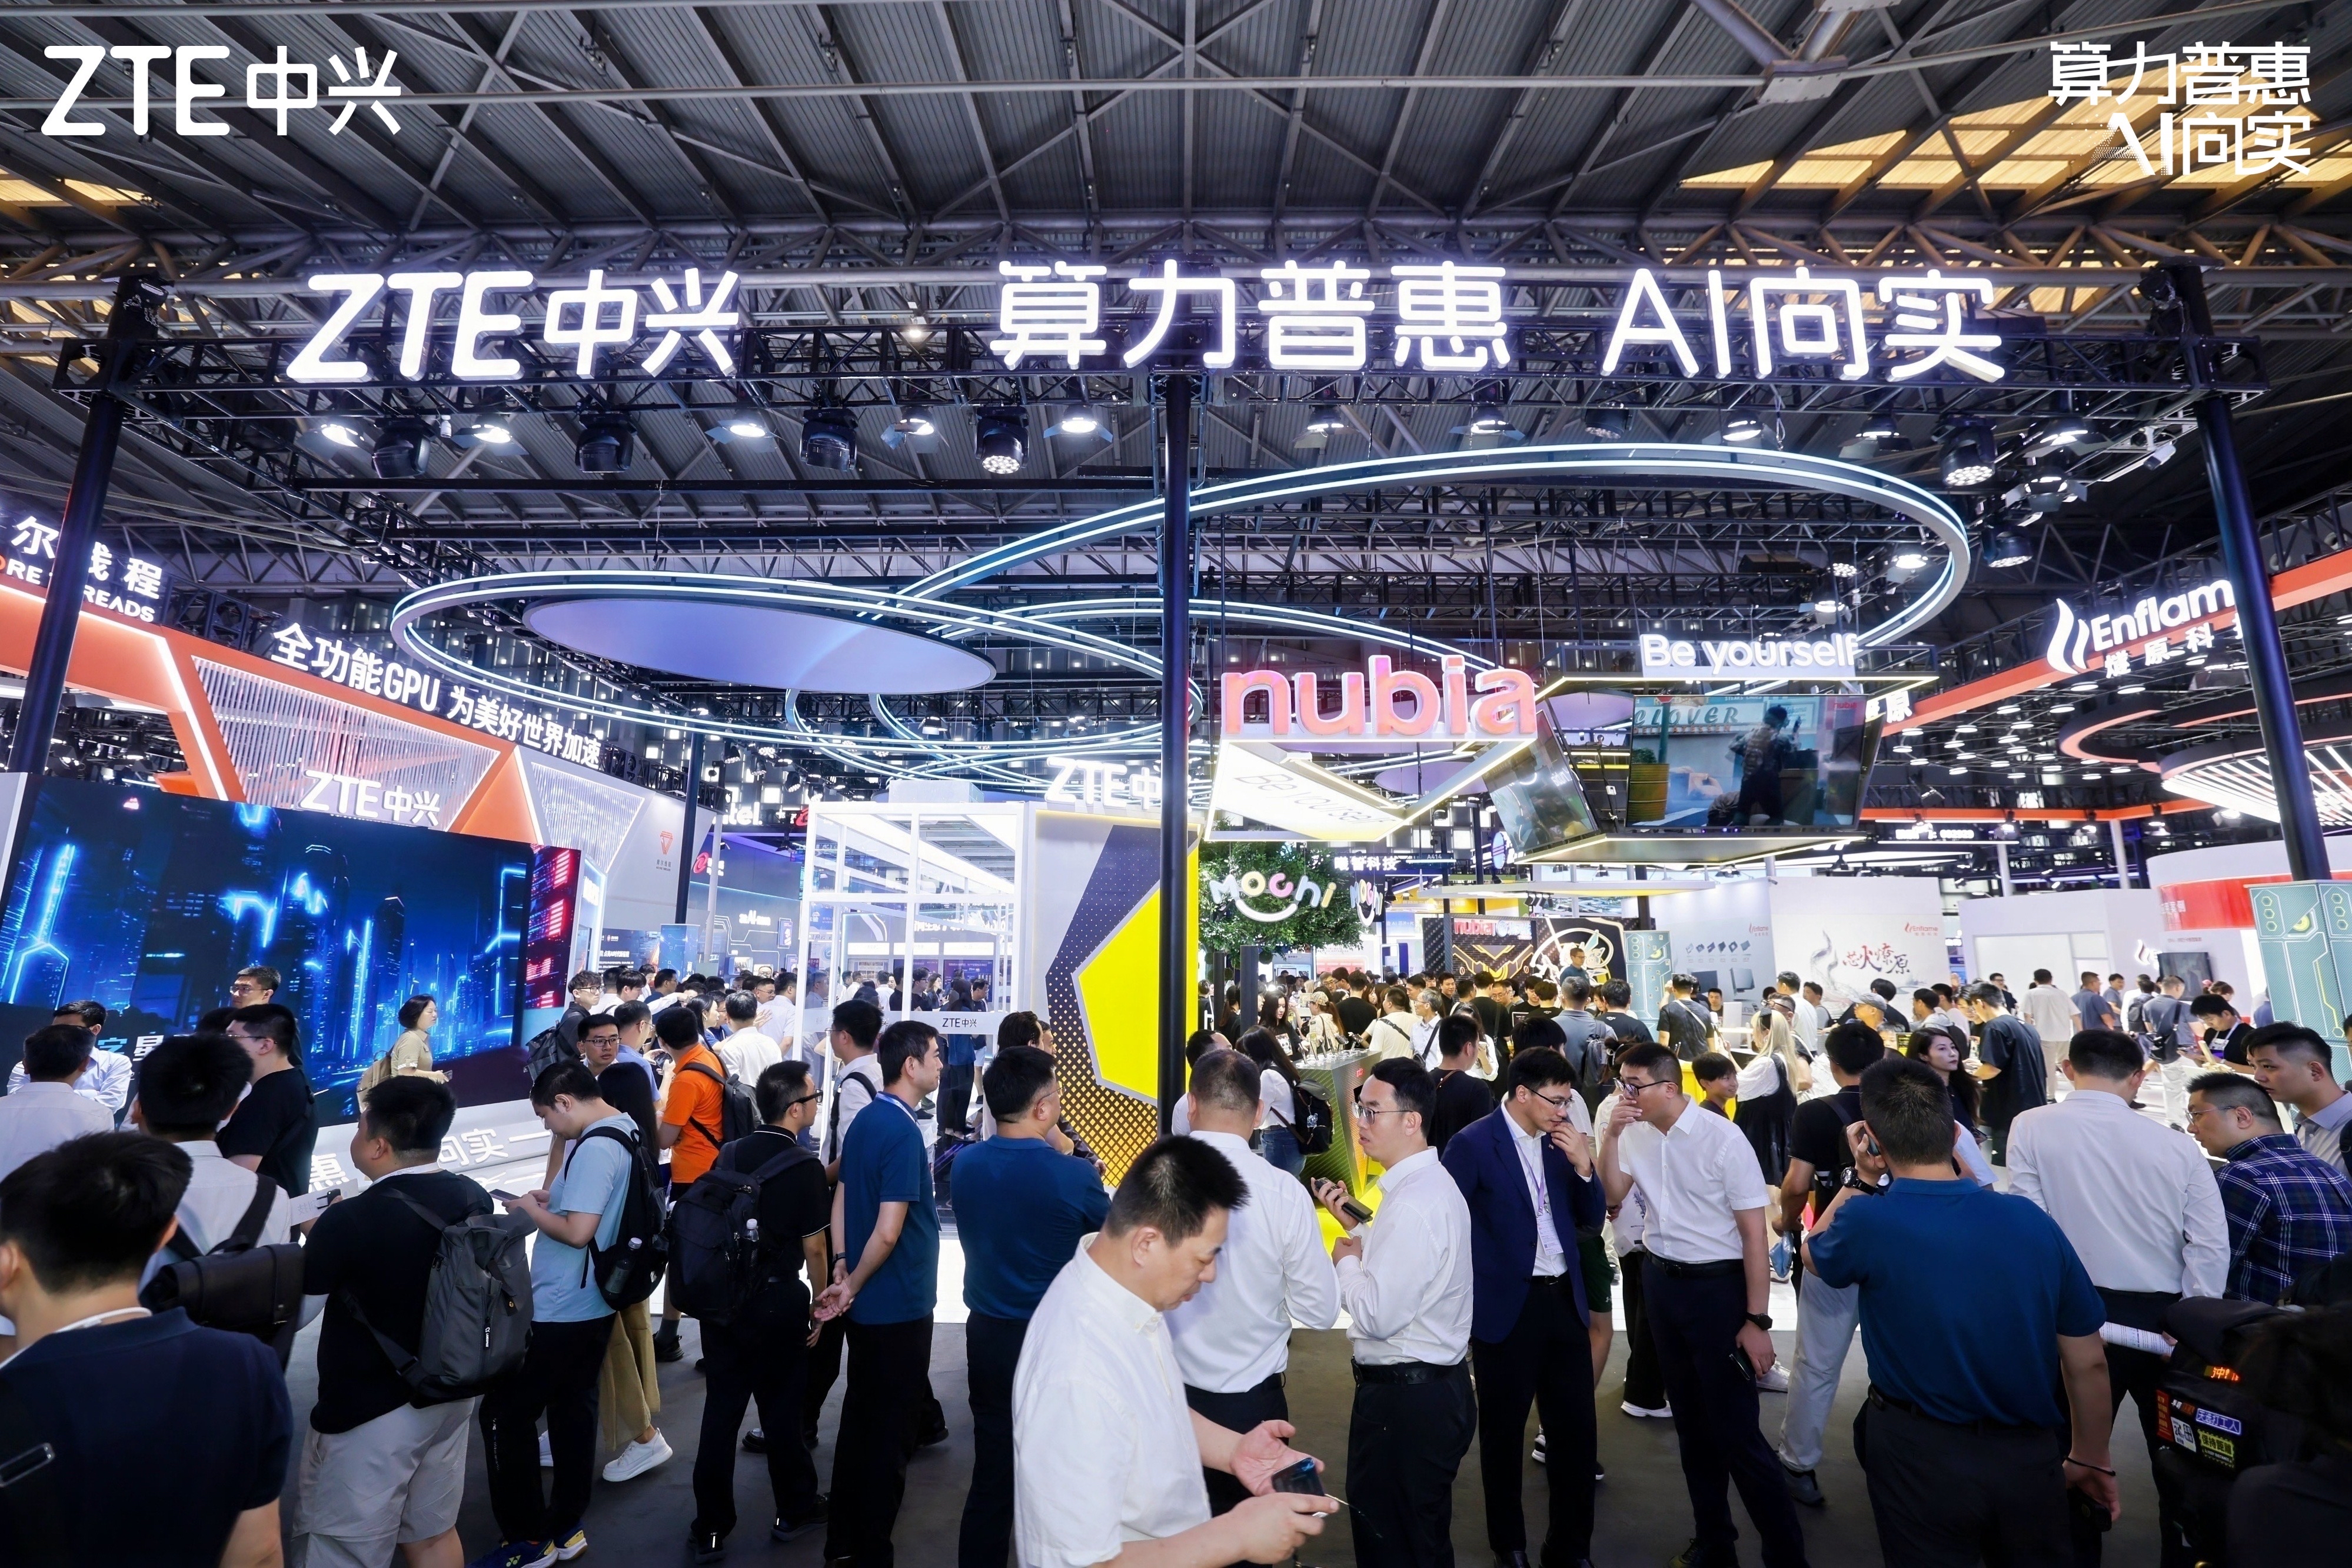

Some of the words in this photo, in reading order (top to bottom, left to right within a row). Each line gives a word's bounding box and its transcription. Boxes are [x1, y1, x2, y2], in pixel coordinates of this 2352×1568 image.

[990, 259, 1511, 372] 算力普惠
[1601, 267, 2005, 382] AI向实
[2091, 580, 2235, 651] Enflam
[1644, 634, 1696, 667] Be
[1701, 633, 1859, 675] yourself
[271, 622, 440, 711] 全功能GPU
[450, 686, 601, 769] 为美好世界加速
[1222, 655, 1537, 735] nubia
[1634, 707, 1739, 727] CLOVER
[1634, 724, 1731, 734] DELIATESSEN
[1044, 757, 1192, 813] ZTE中
[1454, 919, 1493, 936] nubia
[438, 1128, 508, 1167] 向实
